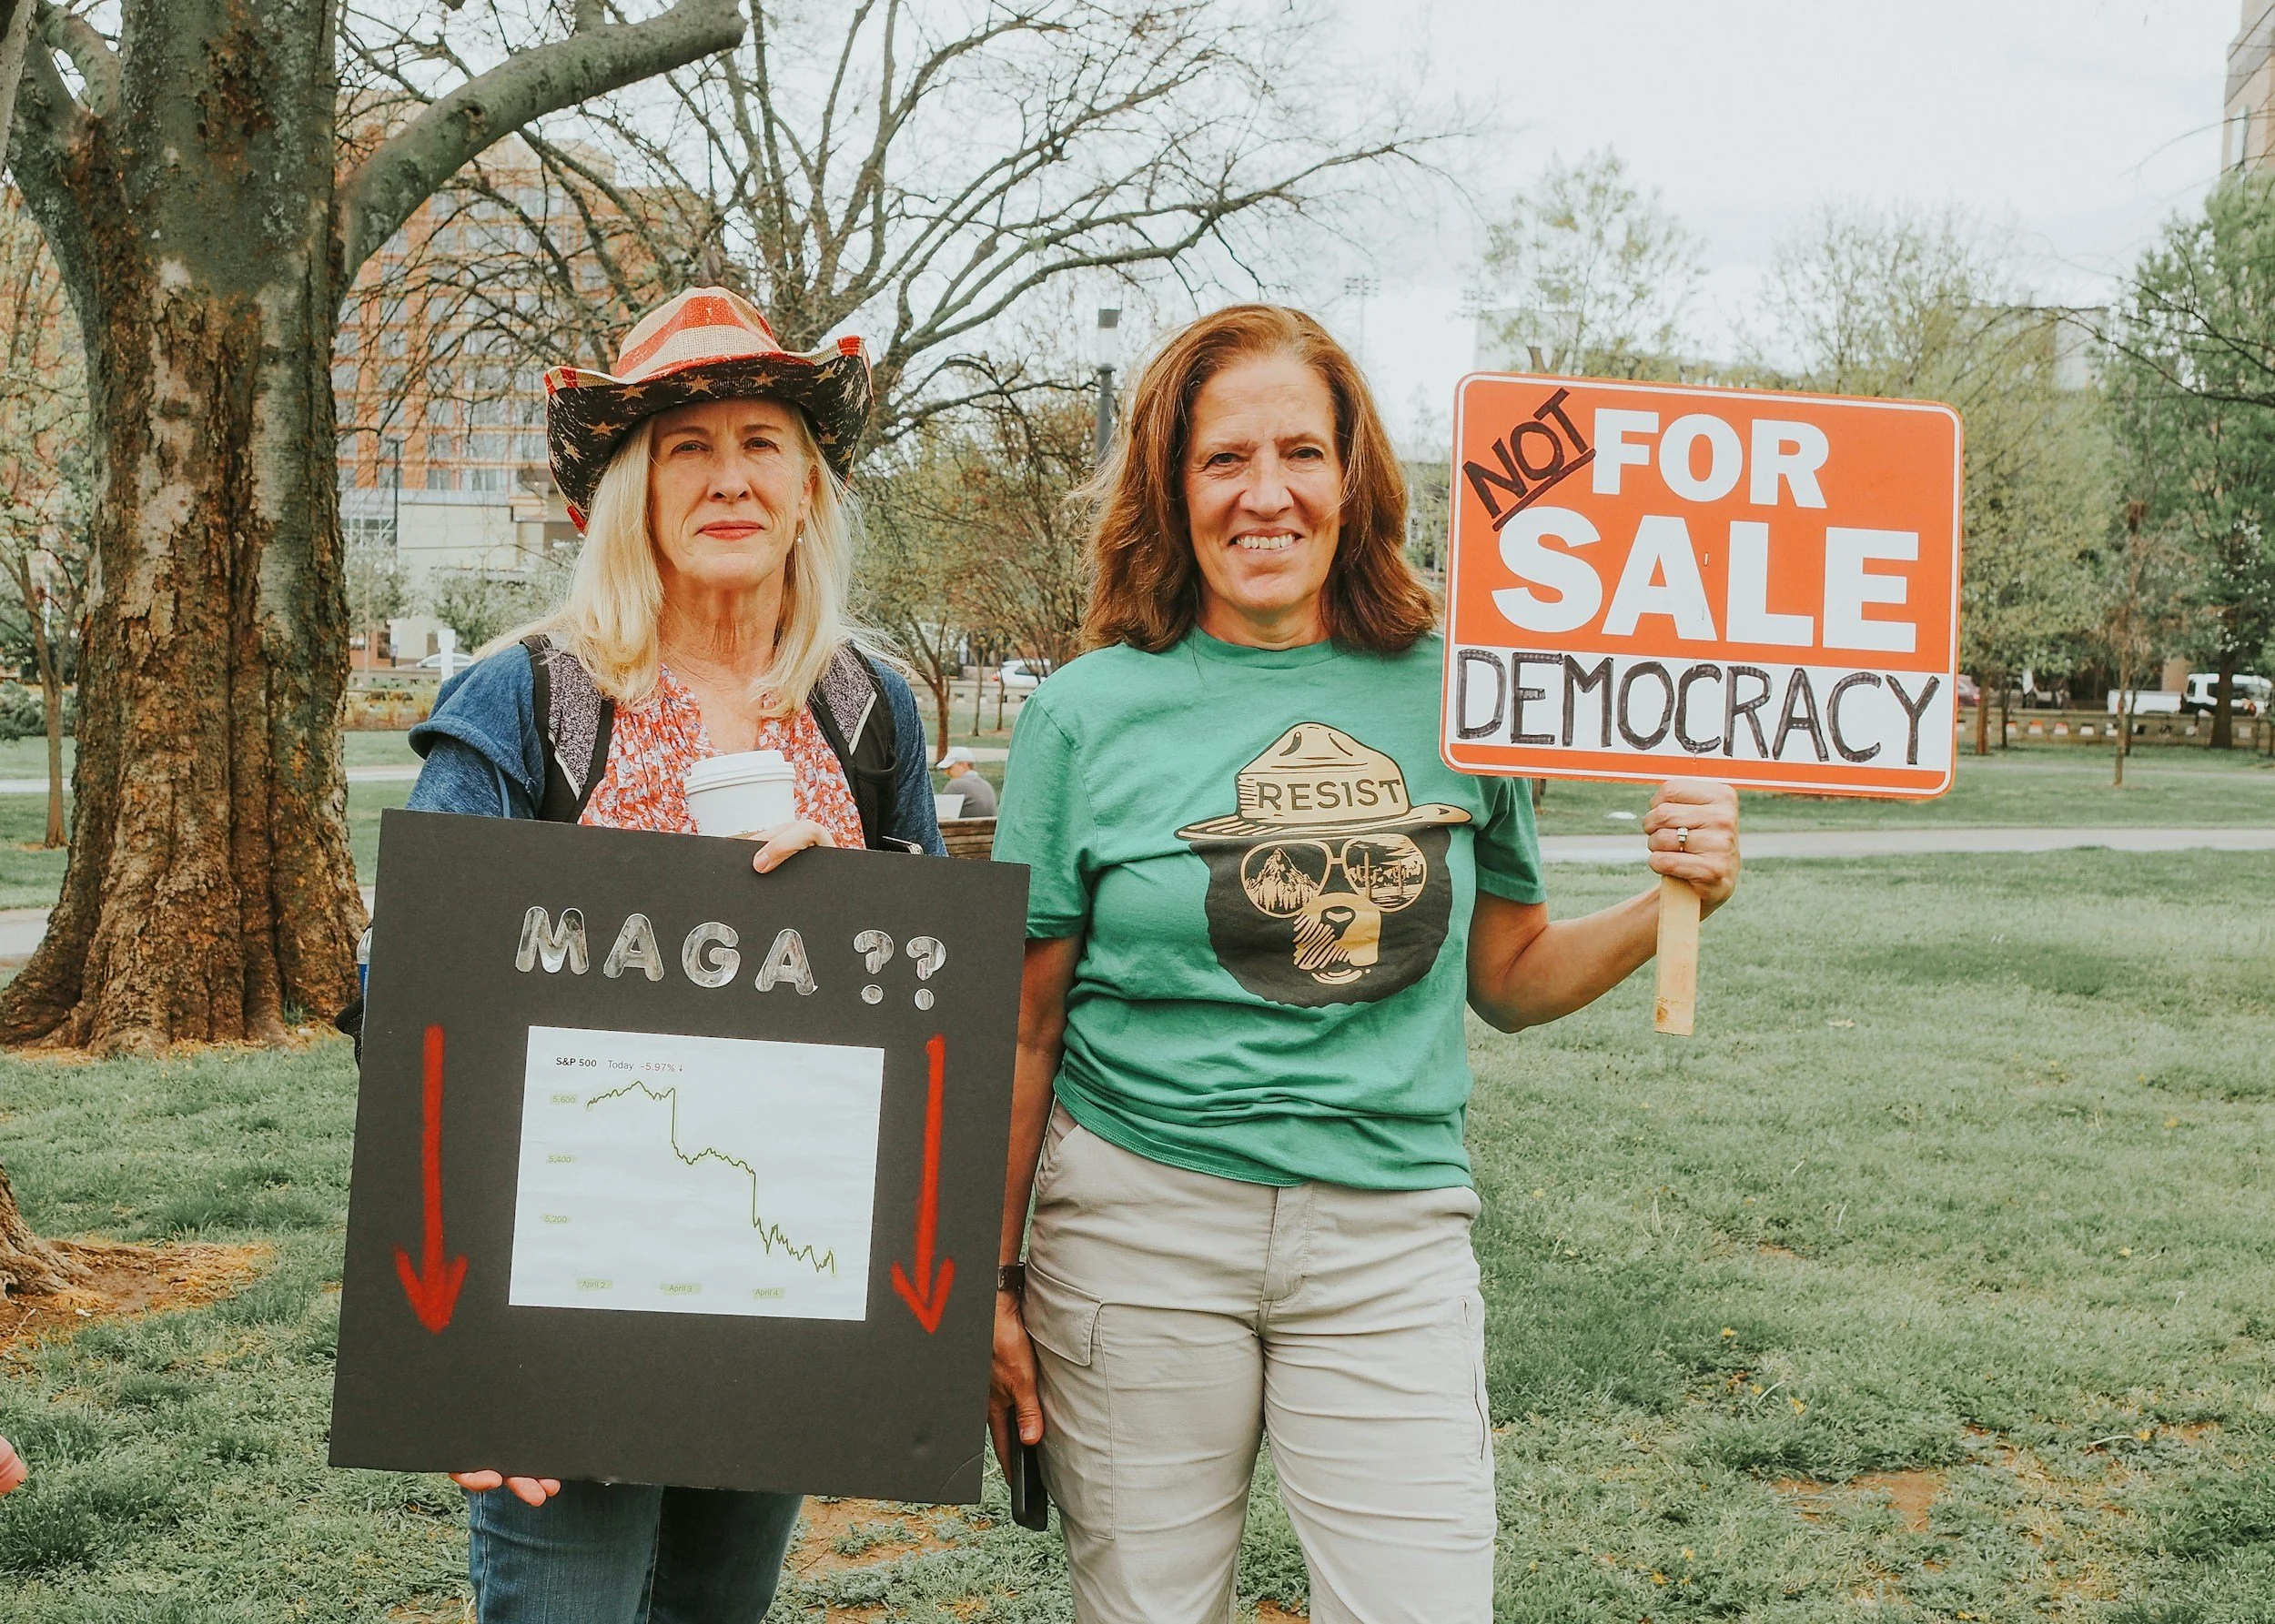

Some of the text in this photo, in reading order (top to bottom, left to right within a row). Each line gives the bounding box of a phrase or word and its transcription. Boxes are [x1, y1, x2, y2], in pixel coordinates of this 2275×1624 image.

[1461, 388, 1591, 519] NOT
[1592, 407, 1829, 509] FOR
[1491, 506, 1919, 653] SALE
[1456, 648, 1940, 766] DEMOCRACY
[1256, 778, 1401, 812] RESIST
[514, 905, 947, 1012] MAGA ??
[555, 1056, 576, 1066] S&P
[578, 1058, 597, 1067] 500
[607, 1060, 634, 1072] Today
[552, 1095, 576, 1104] 5,600
[581, 1280, 599, 1289] April
[668, 1284, 686, 1293] April
[754, 1288, 772, 1296] April
